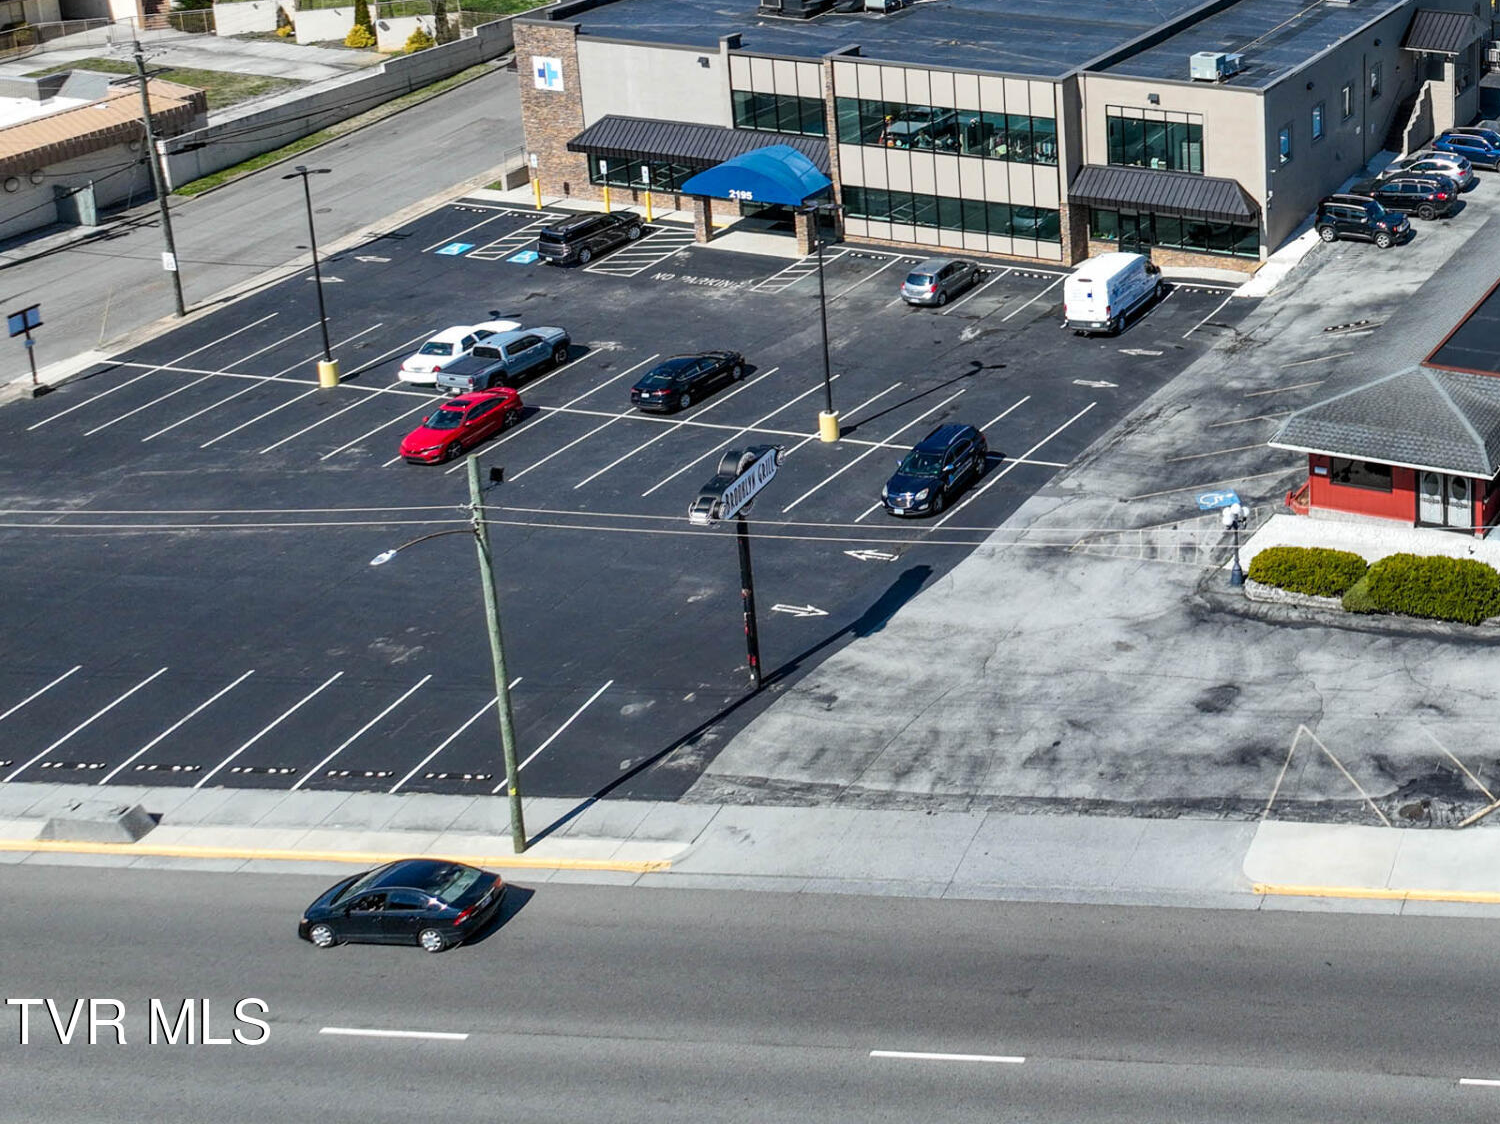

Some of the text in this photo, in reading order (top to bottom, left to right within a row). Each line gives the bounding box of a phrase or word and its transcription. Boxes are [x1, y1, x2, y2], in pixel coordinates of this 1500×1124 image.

[728, 189, 753, 201] 2195
[649, 272, 676, 281] NO
[757, 454, 775, 484] GRILL
